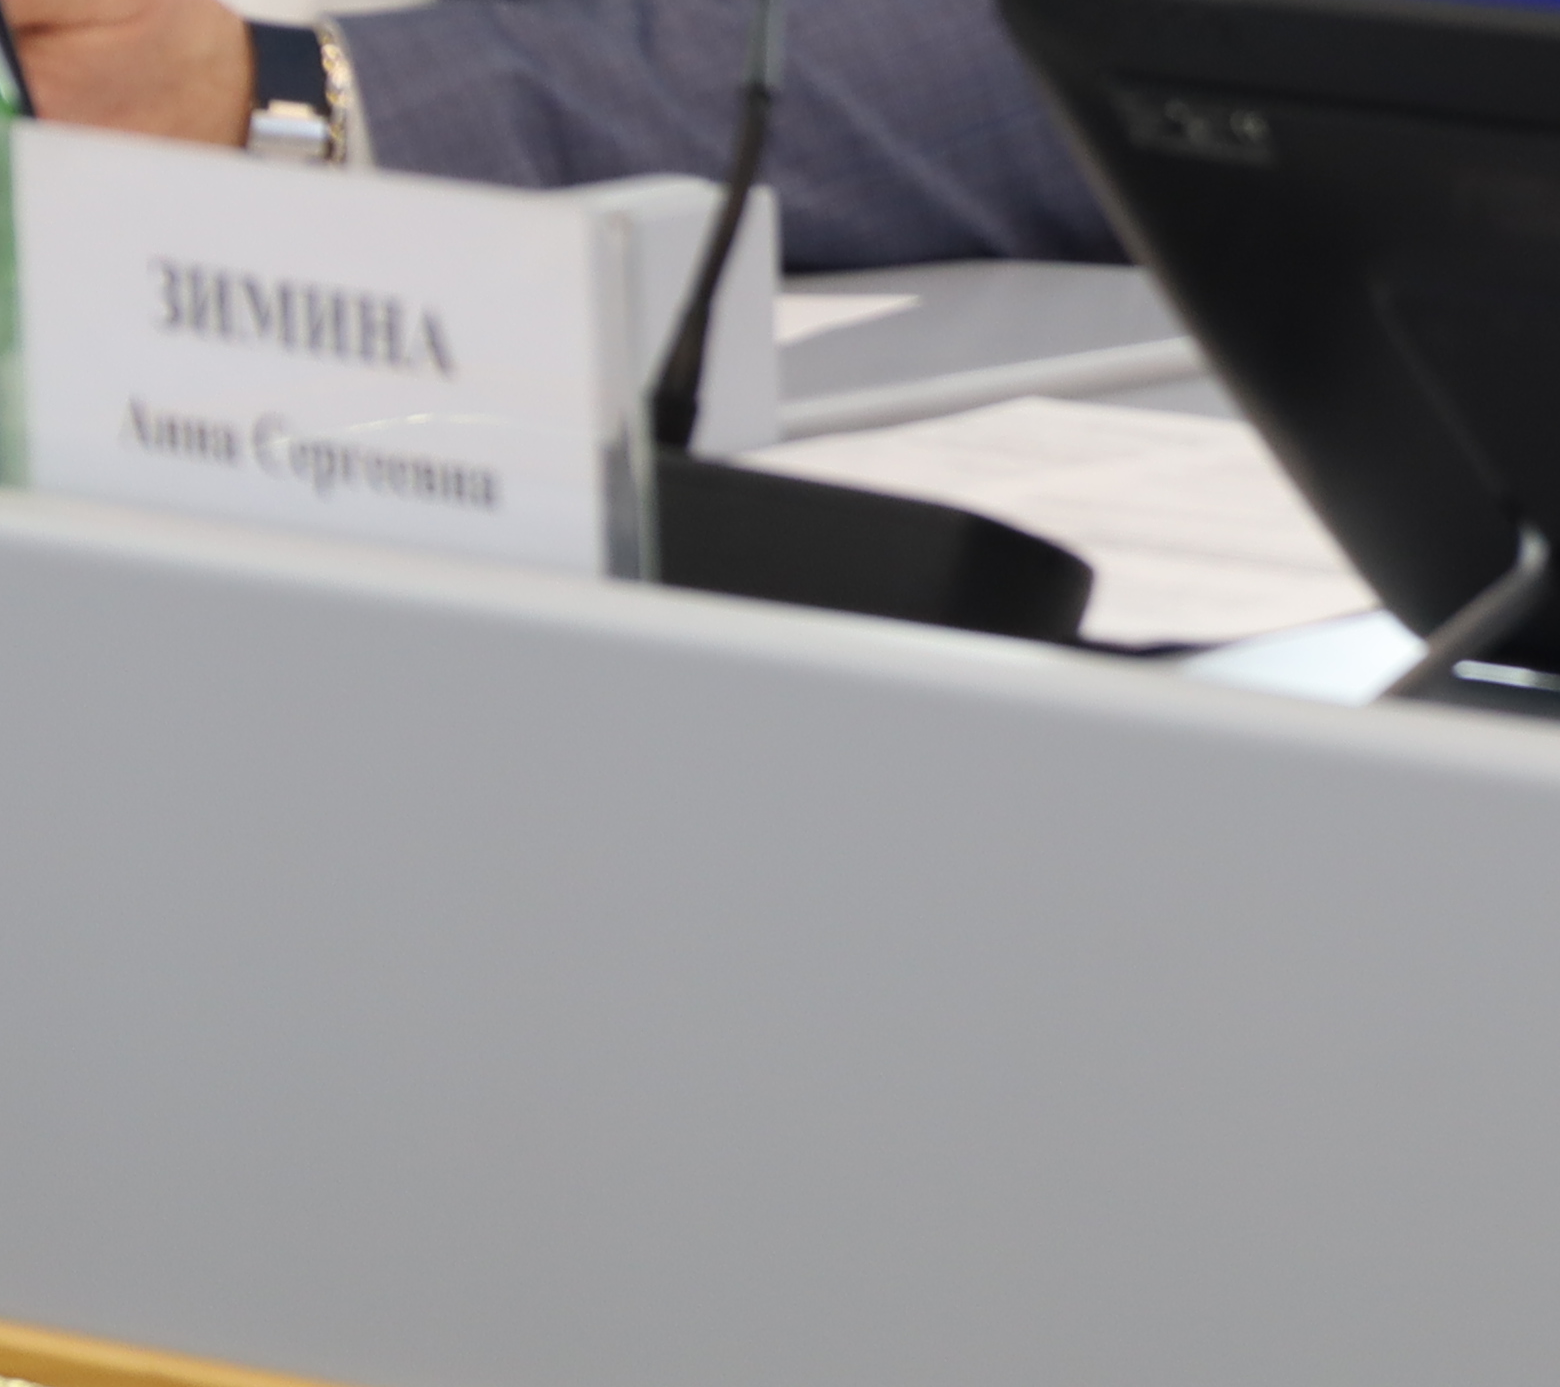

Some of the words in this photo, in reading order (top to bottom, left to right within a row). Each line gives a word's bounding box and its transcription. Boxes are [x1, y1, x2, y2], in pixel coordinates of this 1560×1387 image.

[154, 258, 454, 376] ЗИМИНА
[126, 399, 240, 463] Анна
[251, 415, 498, 511] Сергеевна
